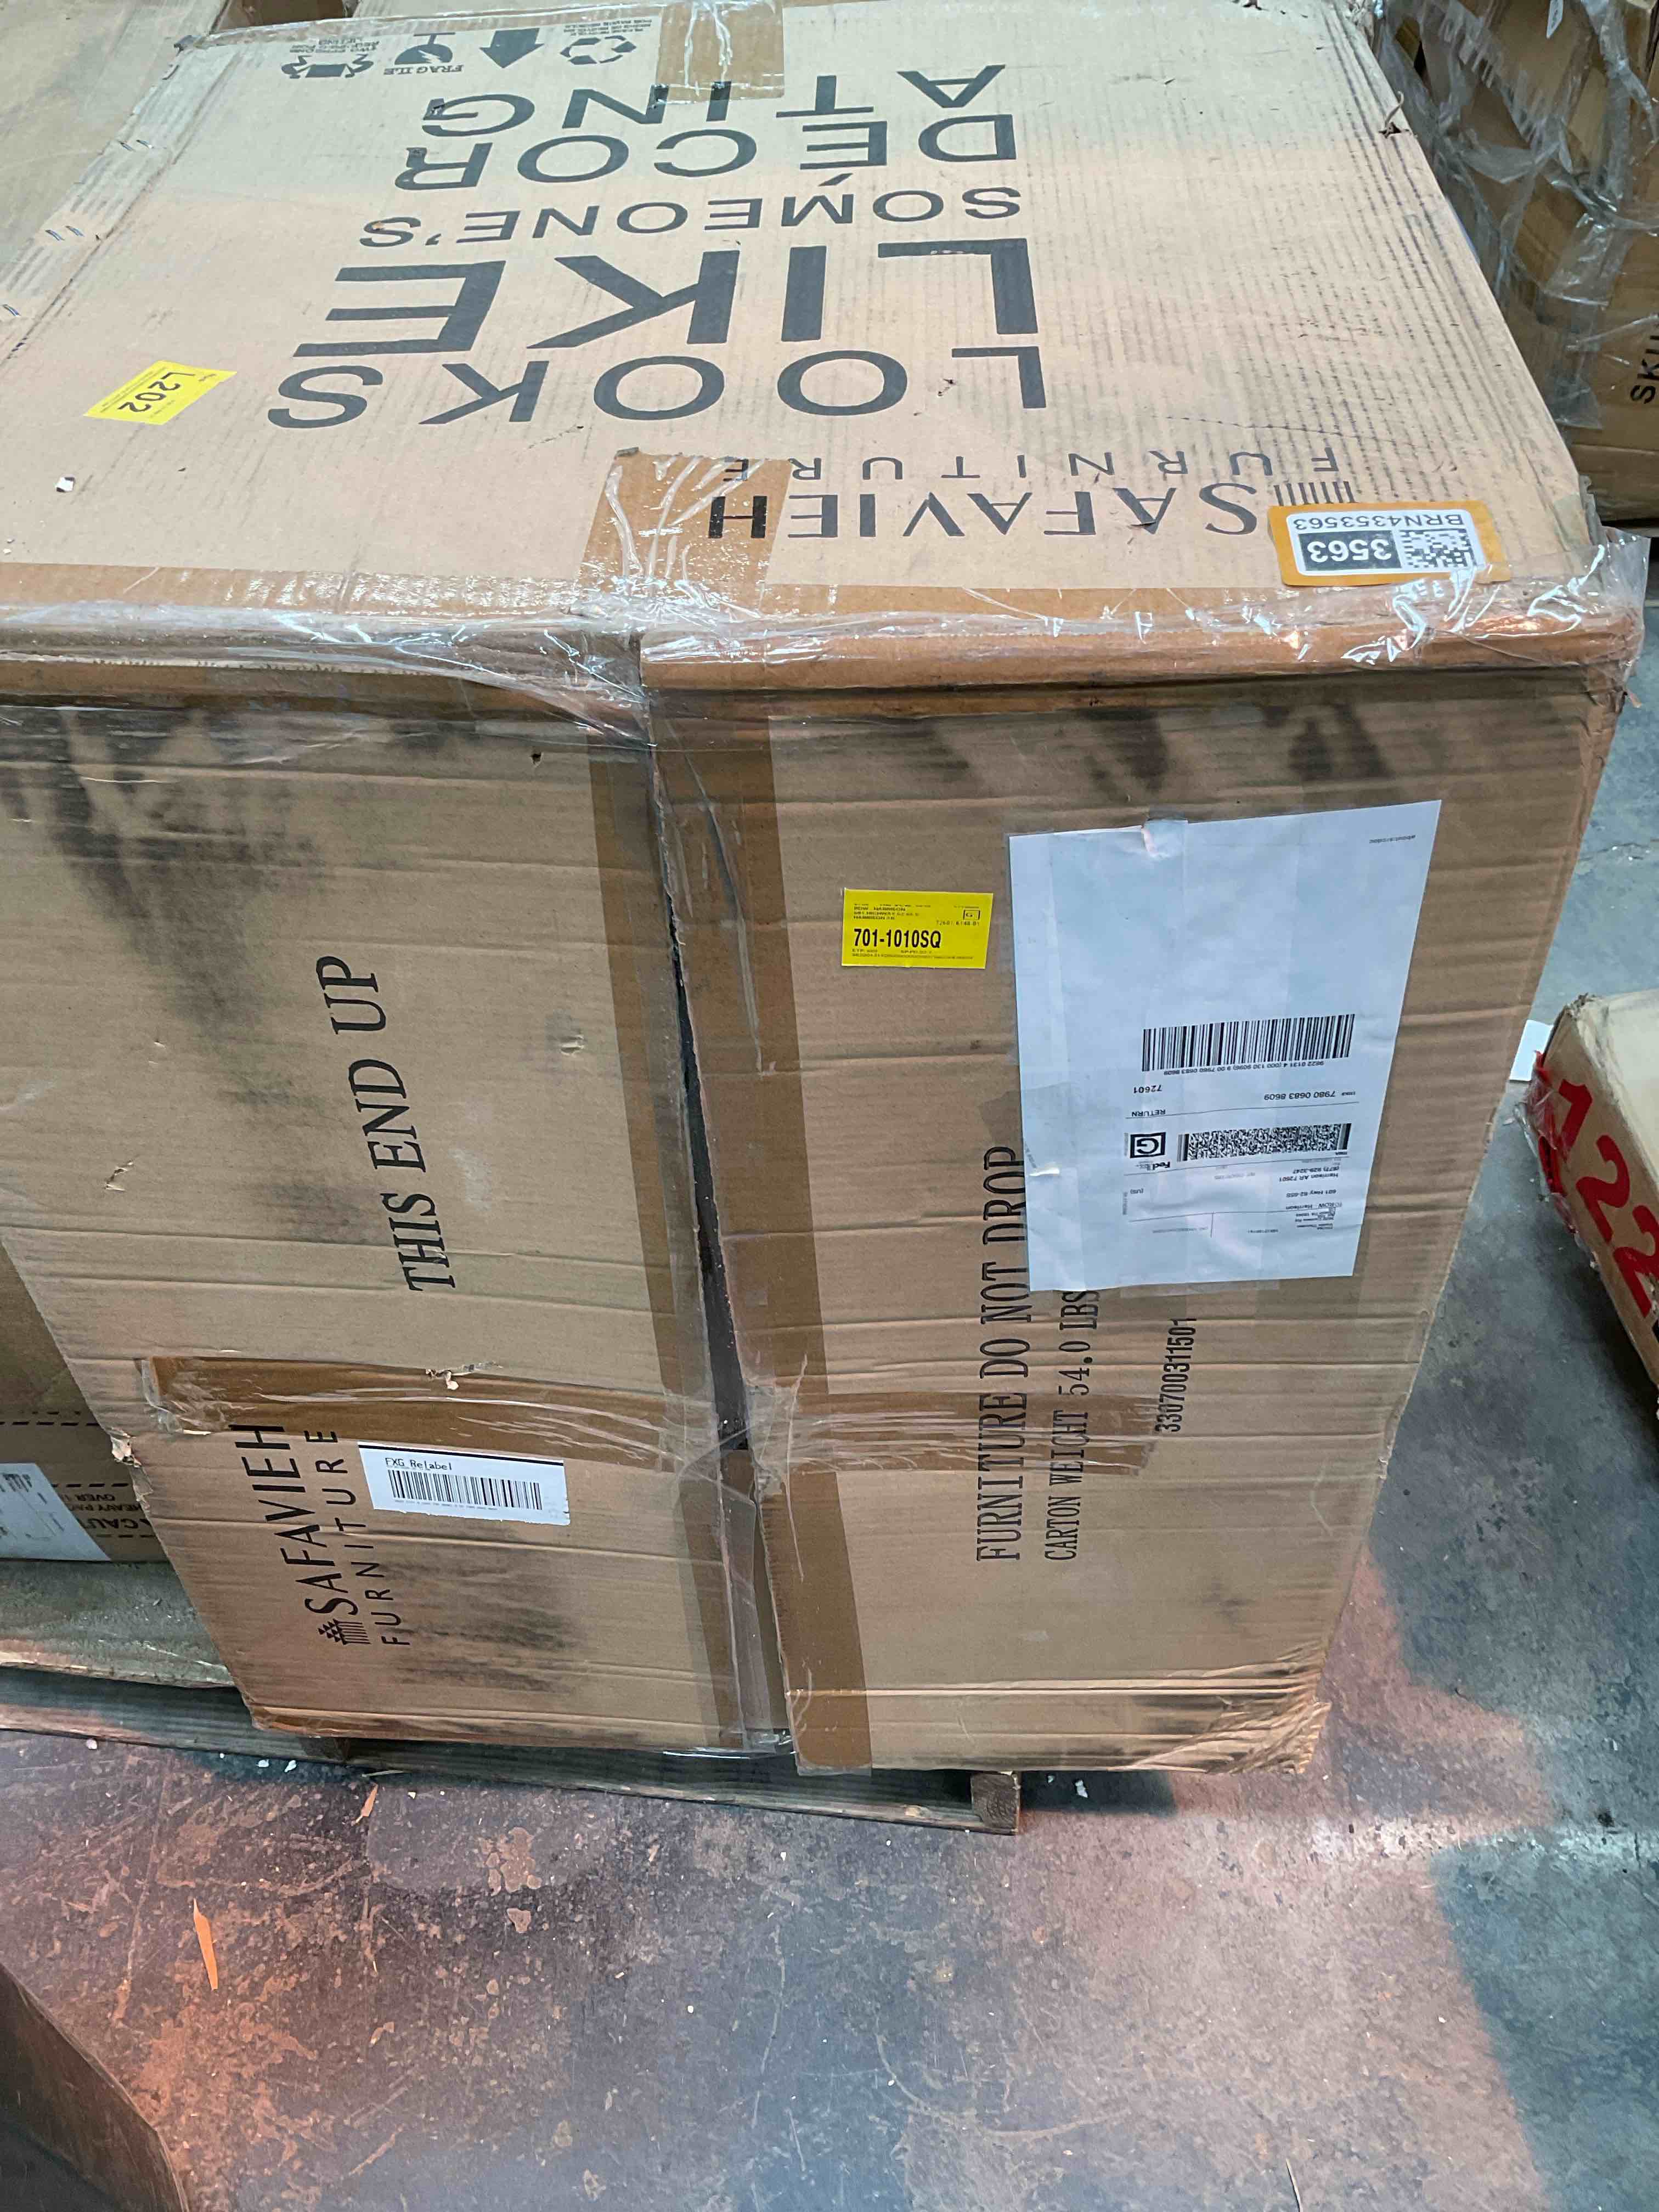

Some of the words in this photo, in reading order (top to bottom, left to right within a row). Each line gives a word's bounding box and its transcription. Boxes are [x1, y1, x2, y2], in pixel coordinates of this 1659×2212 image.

[383, 64, 464, 75] FRAGILE
[422, 64, 1006, 137] ATING
[394, 113, 1018, 190] DÉCOR
[358, 187, 1023, 248] SOMEONE'S
[293, 237, 1038, 358] LIKE
[117, 373, 196, 413] L202
[267, 346, 1047, 429] LOOKS
[723, 447, 1339, 482] FURNITURE
[708, 483, 1258, 539] SAFAVIEH
[1293, 514, 1463, 531] BRN4353563
[1307, 539, 1392, 563] 3563
[854, 928, 941, 949] 701-1010SQ
[316, 956, 386, 1035] UP
[348, 1059, 426, 1173] END
[1133, 1085, 1162, 1094] 72601
[1137, 1138, 1159, 1155] G
[982, 1147, 1028, 1245] DROP
[380, 1193, 455, 1291] THIS
[980, 1262, 1032, 1325] NOT
[979, 1339, 1030, 1379] DO
[1058, 1341, 1093, 1396] 54.0
[1155, 1318, 1197, 1432] 330700311501
[385, 1458, 404, 1467] FXG
[410, 1460, 452, 1470] Relabel
[977, 1393, 1028, 1561] FURNITURE
[228, 1425, 358, 1615] SAFAVIEH
[304, 1431, 410, 1646] FURNITURE
[1045, 1496, 1081, 1560] CARTON
